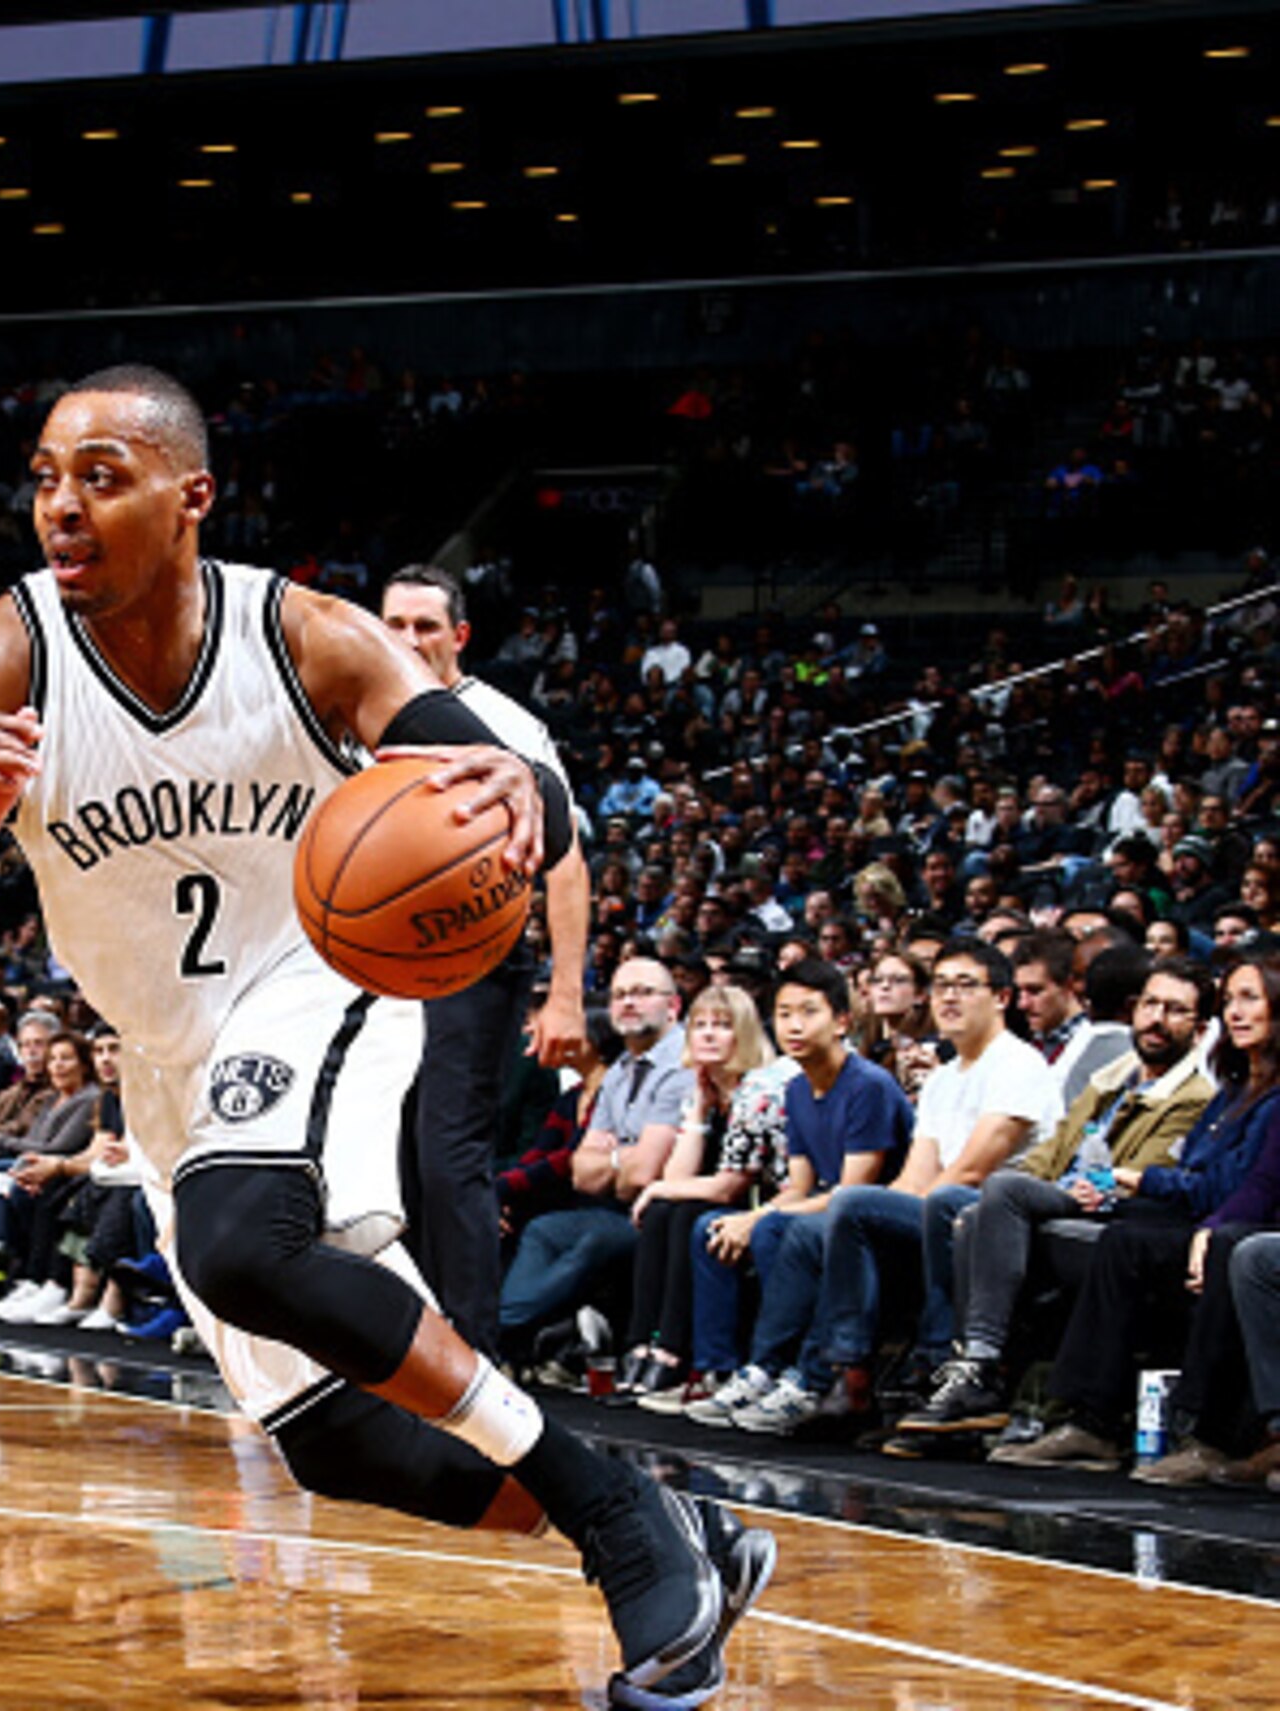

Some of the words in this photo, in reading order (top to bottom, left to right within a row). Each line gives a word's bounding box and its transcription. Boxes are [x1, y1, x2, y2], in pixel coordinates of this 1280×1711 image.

[47, 779, 316, 871] BROOKLYN
[176, 874, 226, 977] 2
[211, 1057, 296, 1093] NETS
